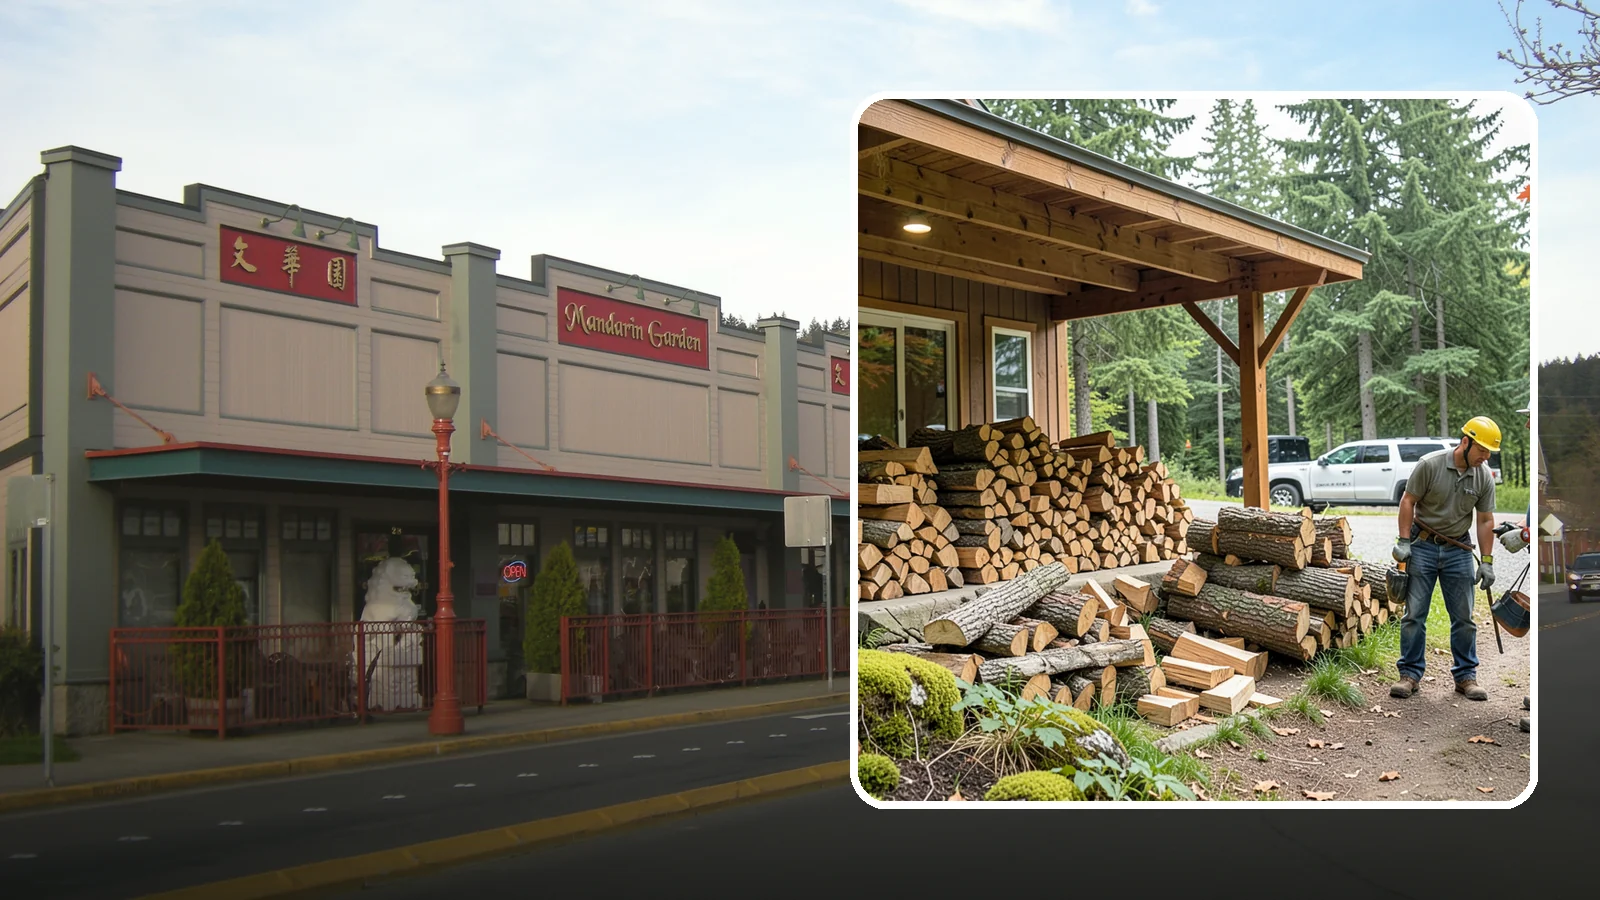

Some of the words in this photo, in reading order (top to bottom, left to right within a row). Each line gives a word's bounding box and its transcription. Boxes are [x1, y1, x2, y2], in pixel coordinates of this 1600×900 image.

[230, 235, 346, 291] 文華園
[564, 301, 644, 341] Mandarin
[647, 320, 701, 352] Garden
[503, 565, 527, 578] OPEN
